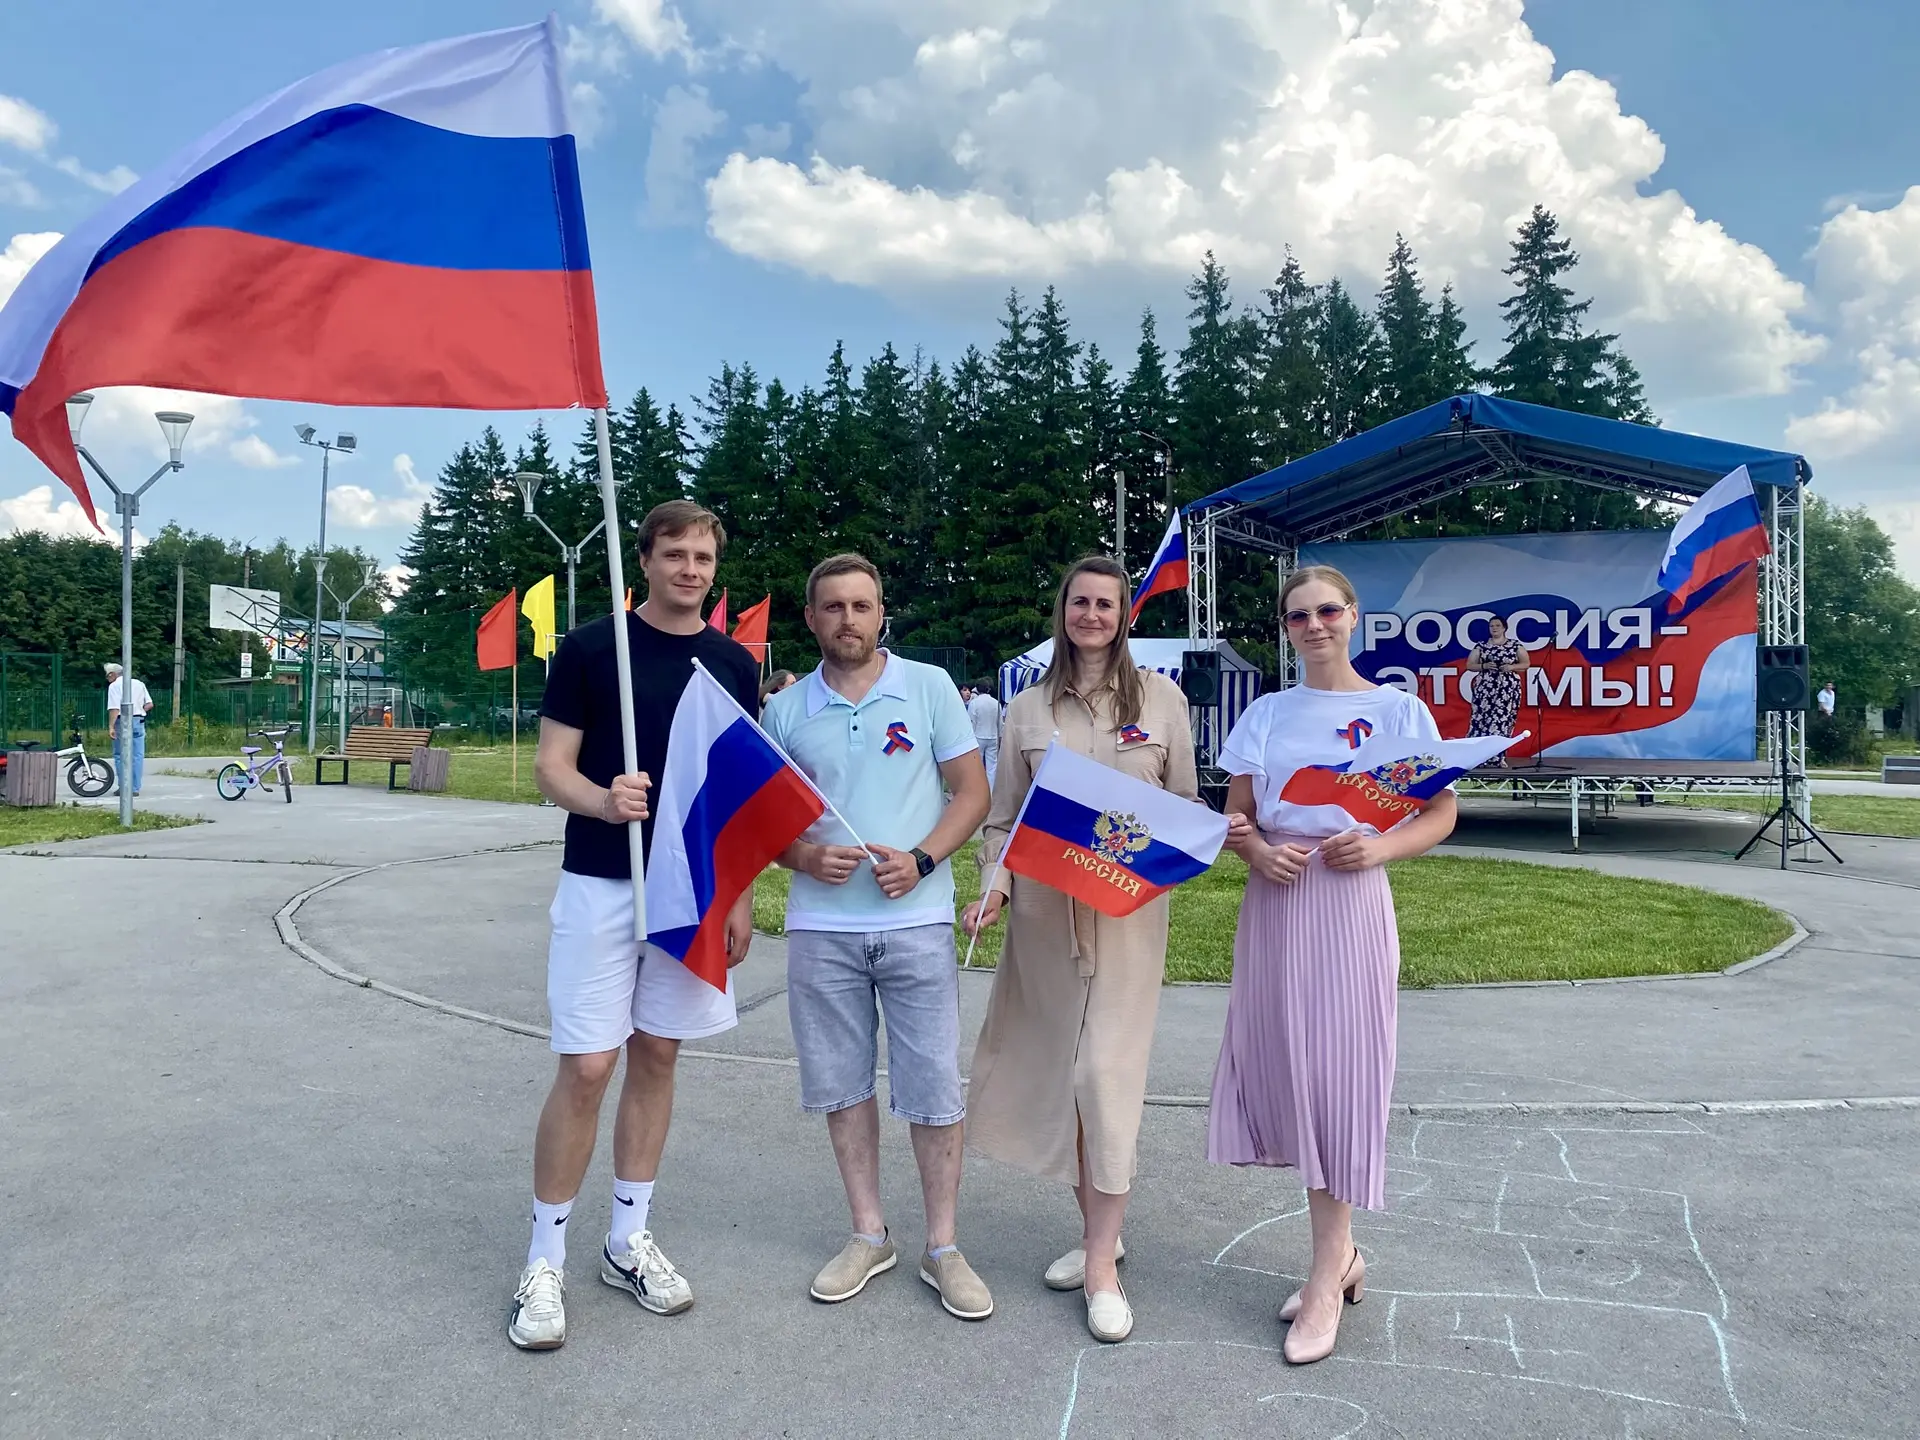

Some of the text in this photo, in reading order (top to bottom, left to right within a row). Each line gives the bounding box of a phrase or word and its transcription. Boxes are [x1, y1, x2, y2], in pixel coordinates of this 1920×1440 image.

[1363, 606, 1688, 652] РОССИЯ-
[1526, 664, 1675, 707] МЫ!
[1060, 847, 1142, 898] РОССИЯ
